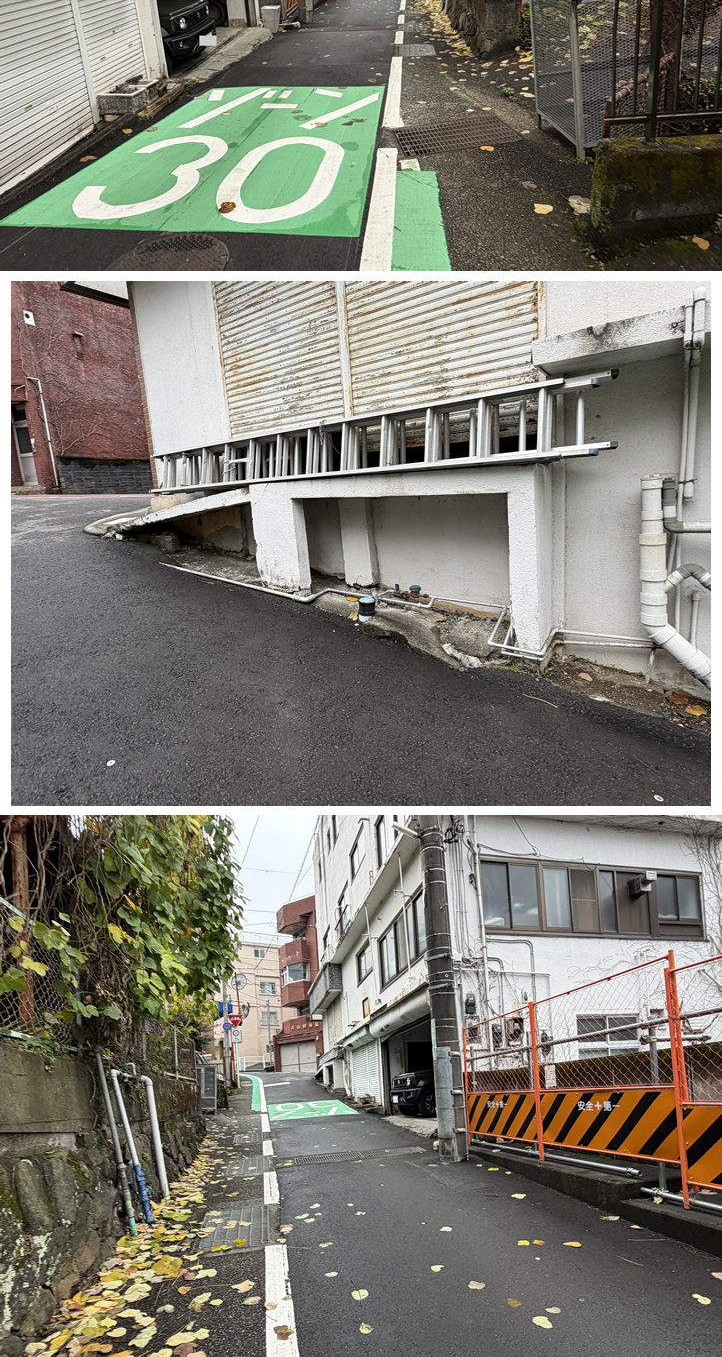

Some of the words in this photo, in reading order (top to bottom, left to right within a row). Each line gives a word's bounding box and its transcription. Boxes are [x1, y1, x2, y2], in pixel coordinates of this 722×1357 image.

[177, 87, 380, 130] ゾーン
[72, 135, 345, 224] 30
